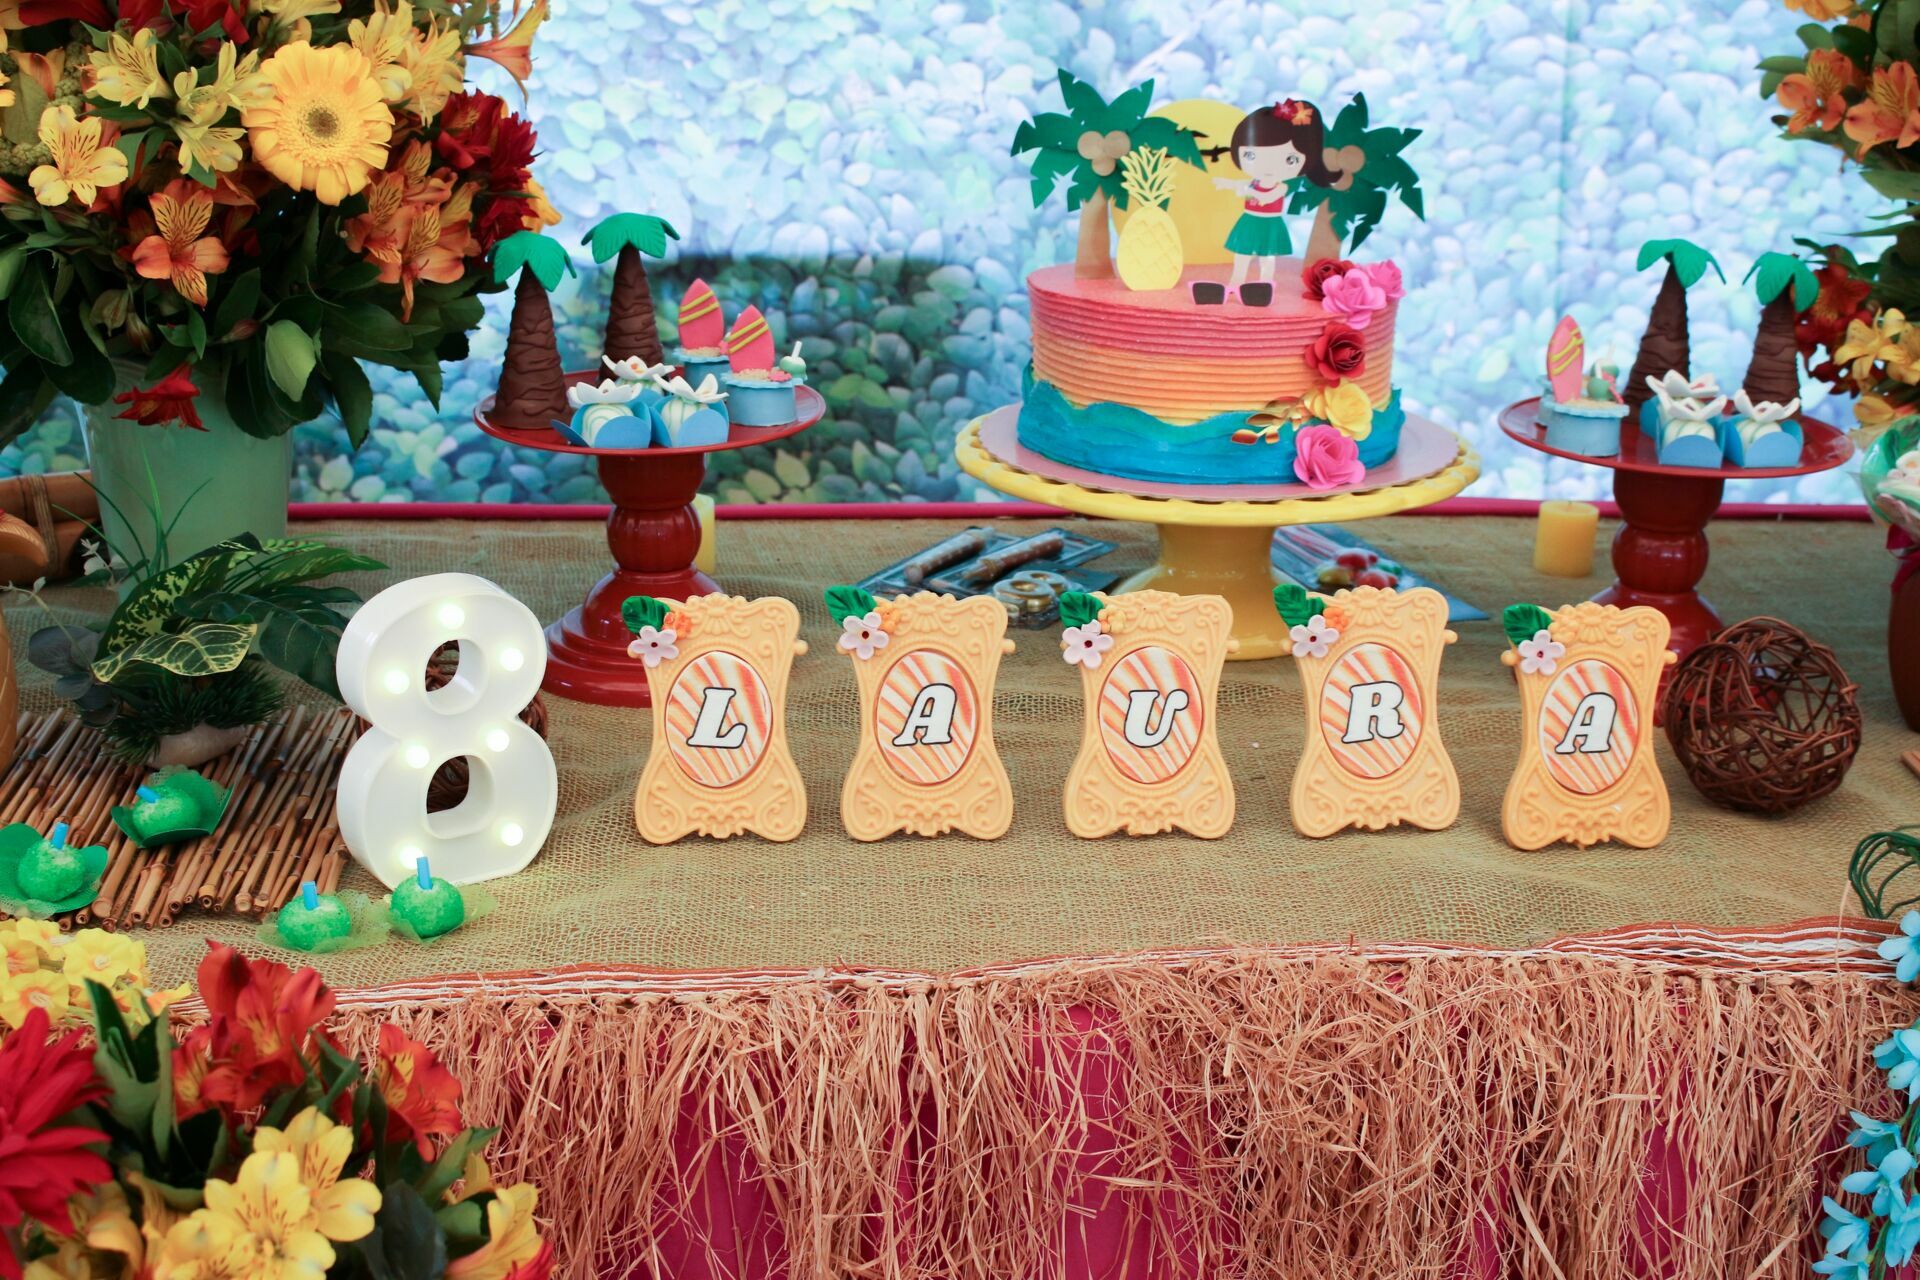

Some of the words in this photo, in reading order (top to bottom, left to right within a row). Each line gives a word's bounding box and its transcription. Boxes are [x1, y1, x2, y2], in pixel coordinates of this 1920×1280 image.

[336, 572, 558, 890] 8
[686, 687, 748, 749] L
[892, 683, 957, 746] A
[1124, 689, 1188, 748] U
[1341, 680, 1405, 744] R
[1555, 692, 1617, 754] A
